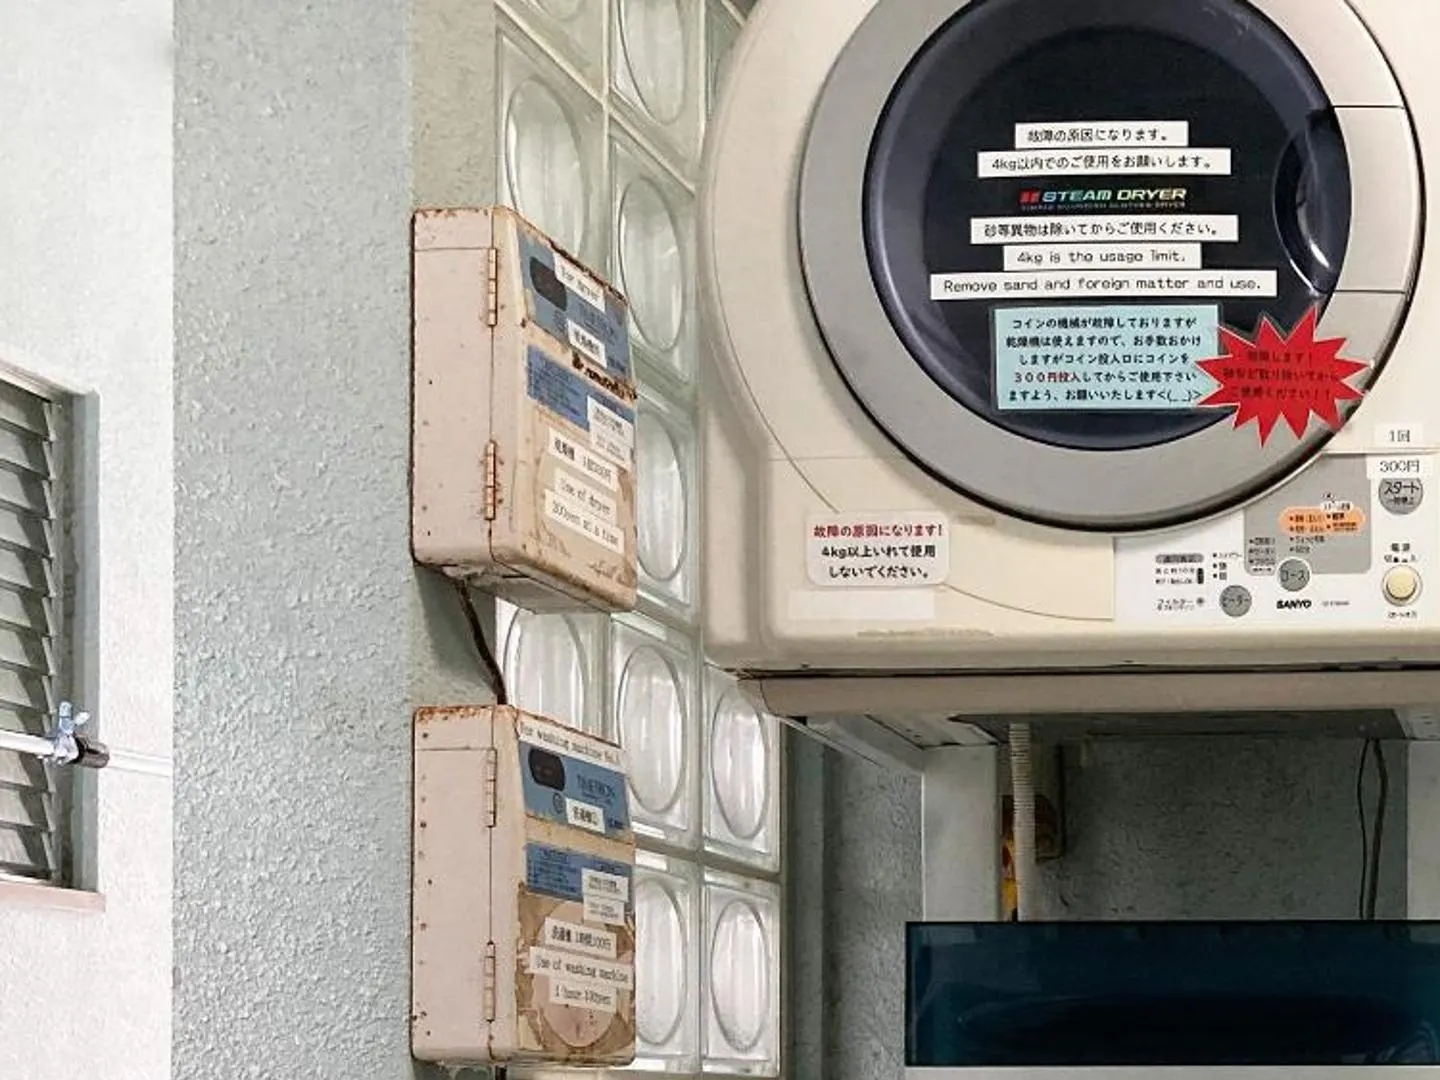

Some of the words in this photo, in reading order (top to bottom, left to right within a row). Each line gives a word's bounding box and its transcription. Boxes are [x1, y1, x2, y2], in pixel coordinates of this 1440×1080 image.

[1028, 128, 1168, 142] 故障の原因になります。
[992, 154, 1212, 171] 4kg以内でのご使用をお願いします。
[1042, 189, 1112, 202] STEAM
[1116, 188, 1187, 201] DRYER
[984, 222, 1218, 237] 砂等異物は除いてからご使用ください。
[1017, 252, 1043, 264] 4kg
[1049, 251, 1061, 263] is
[1069, 250, 1094, 263] the
[1099, 251, 1143, 264] usage
[943, 280, 998, 294] Remove
[1004, 278, 1039, 291] sand
[1044, 277, 1071, 290] and
[1078, 276, 1130, 291] foreign
[1136, 276, 1189, 290] matter
[1197, 276, 1223, 289] and
[1230, 277, 1262, 290] use.
[1276, 599, 1312, 609] SANYO
